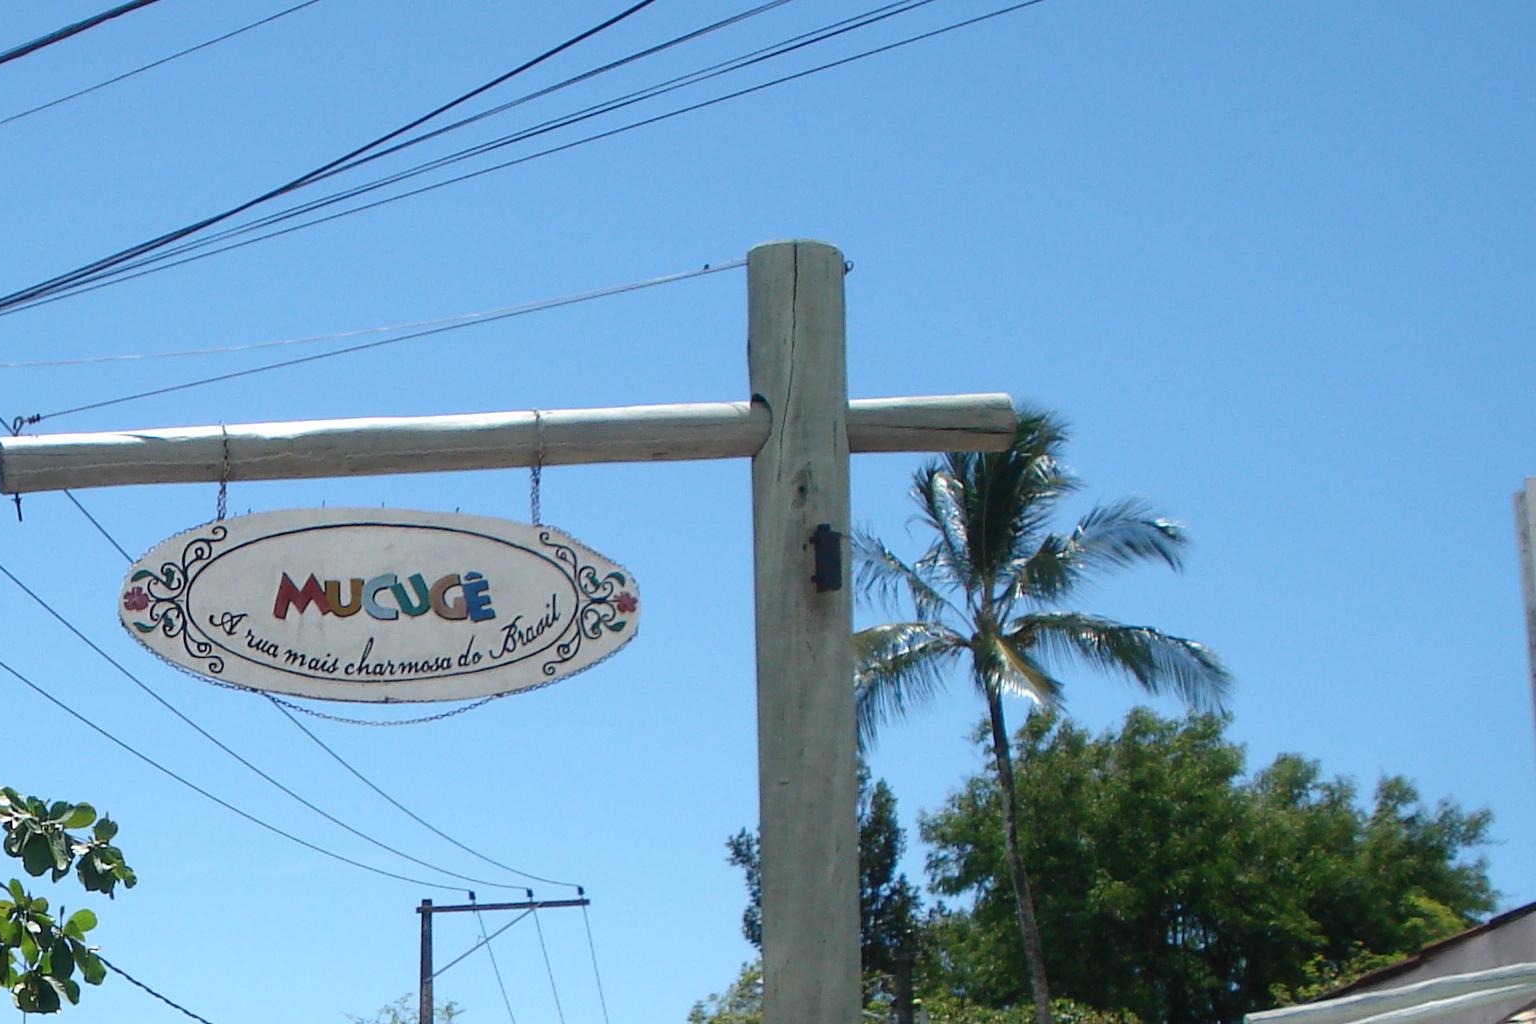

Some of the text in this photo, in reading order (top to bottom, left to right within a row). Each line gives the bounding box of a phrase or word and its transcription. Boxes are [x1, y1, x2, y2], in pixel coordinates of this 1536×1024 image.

[272, 570, 497, 623] MUCUGÊ
[209, 595, 562, 677] A rua mais charmosa do Brasil
